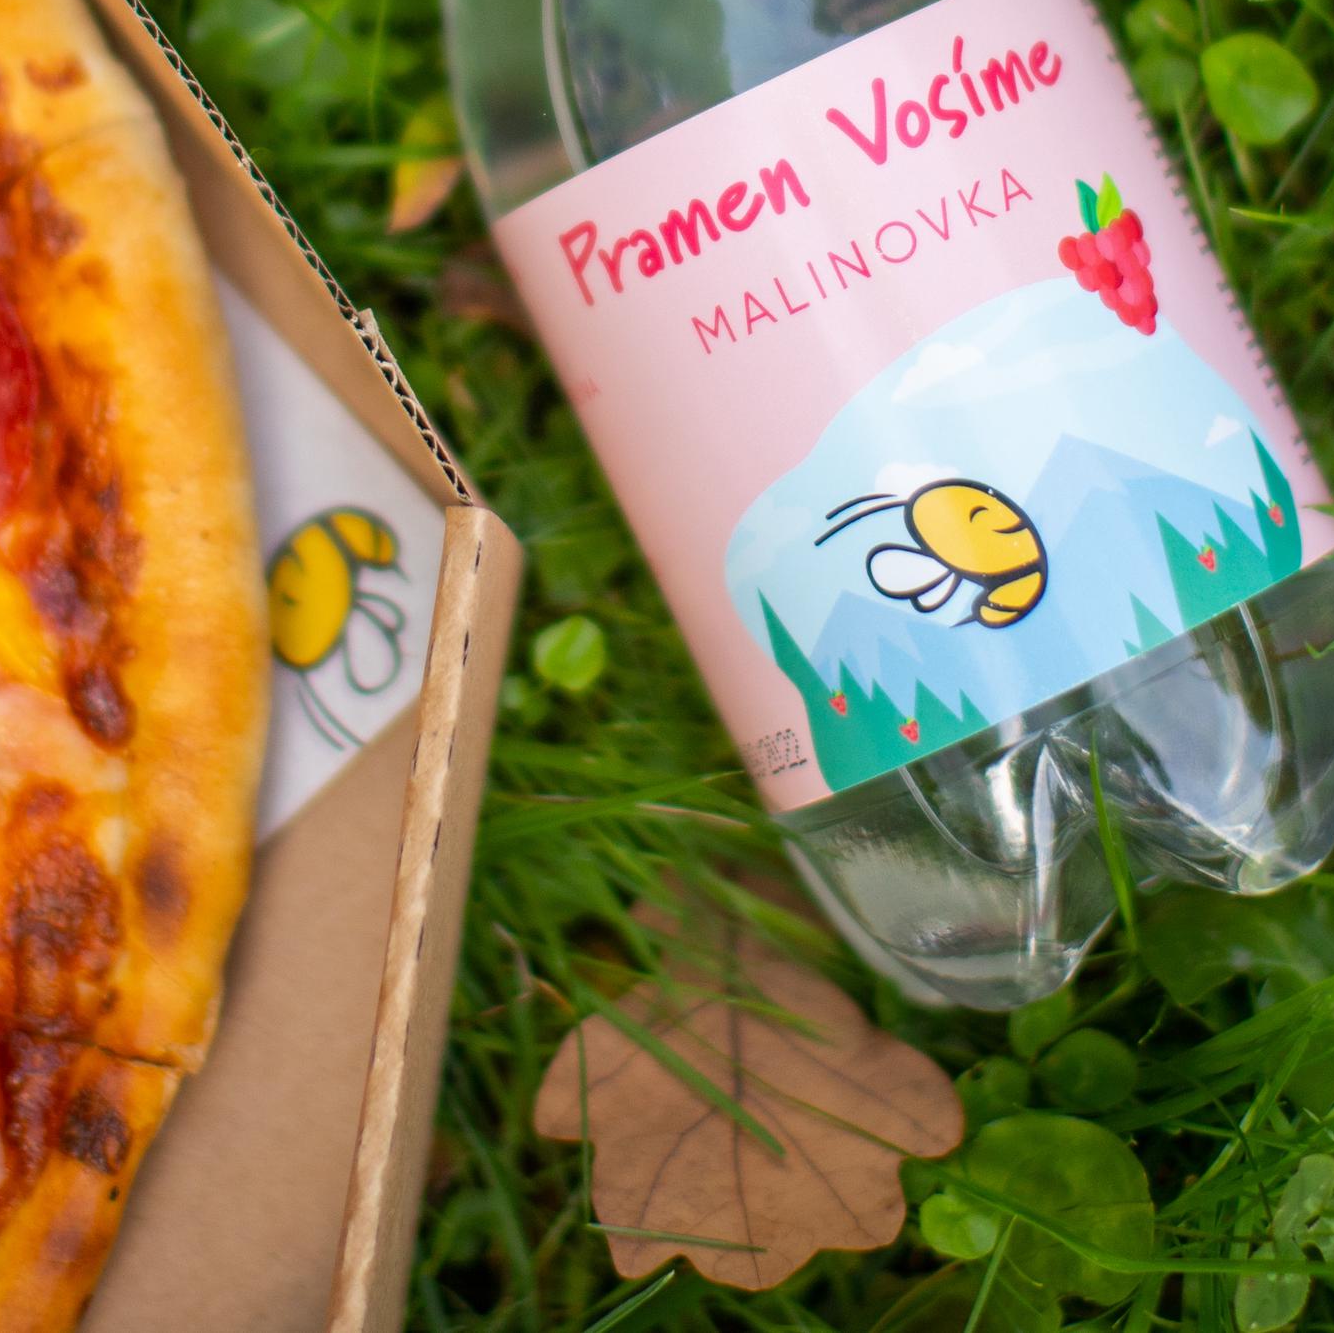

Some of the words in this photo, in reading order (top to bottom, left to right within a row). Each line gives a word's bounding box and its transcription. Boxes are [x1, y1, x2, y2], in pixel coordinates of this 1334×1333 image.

[559, 157, 811, 306] Pramen
[826, 35, 1063, 166] Vosíme
[691, 168, 1034, 355] MALINOVKA
